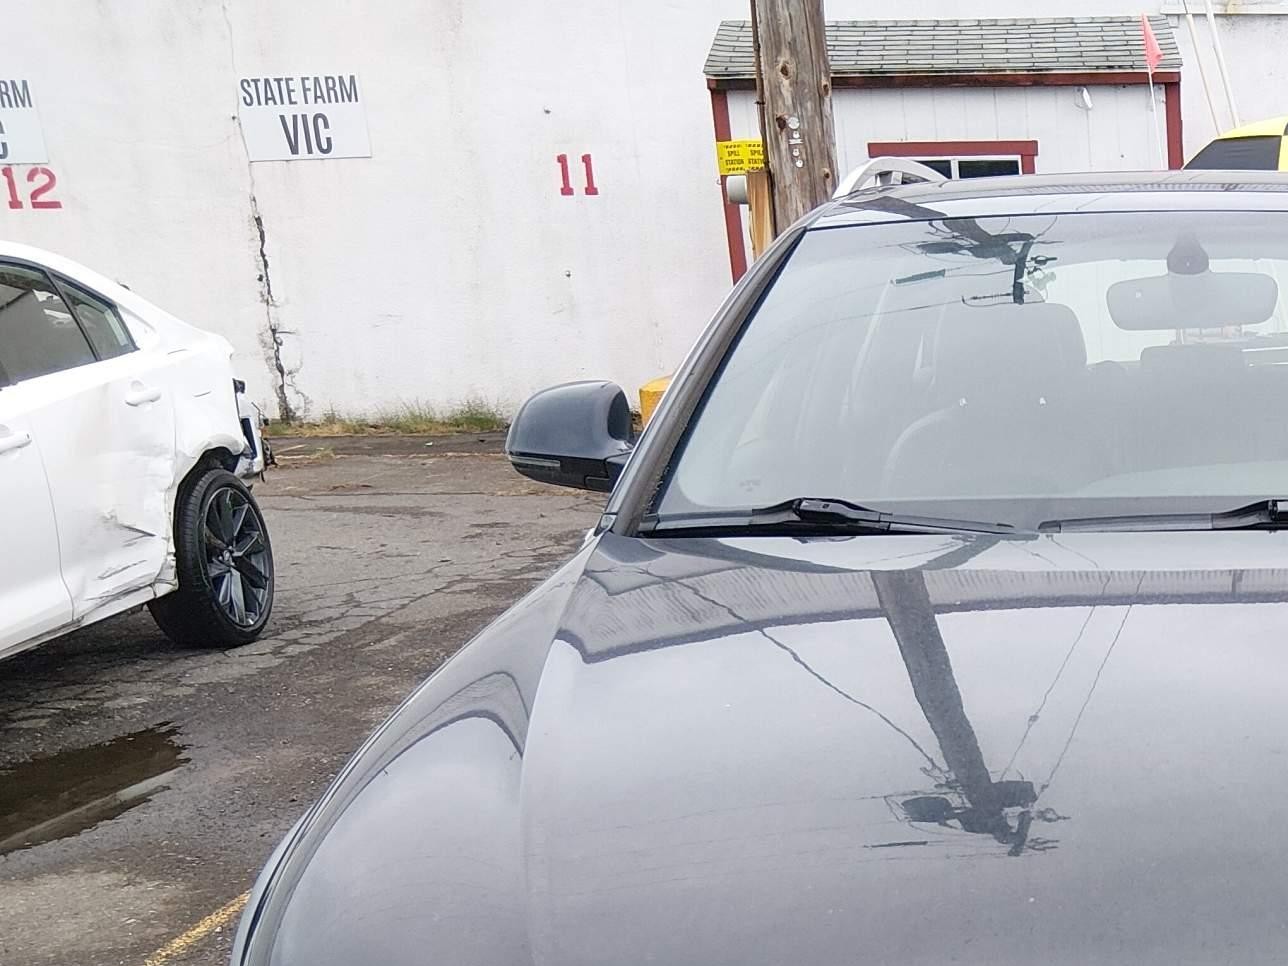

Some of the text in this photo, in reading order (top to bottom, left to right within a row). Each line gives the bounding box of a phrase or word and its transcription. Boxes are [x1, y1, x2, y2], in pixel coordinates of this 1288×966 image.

[0, 79, 33, 109] RM
[240, 74, 359, 107] STATE FARM
[278, 112, 333, 156] VIC
[1, 166, 62, 210] 12
[556, 153, 599, 196] 11
